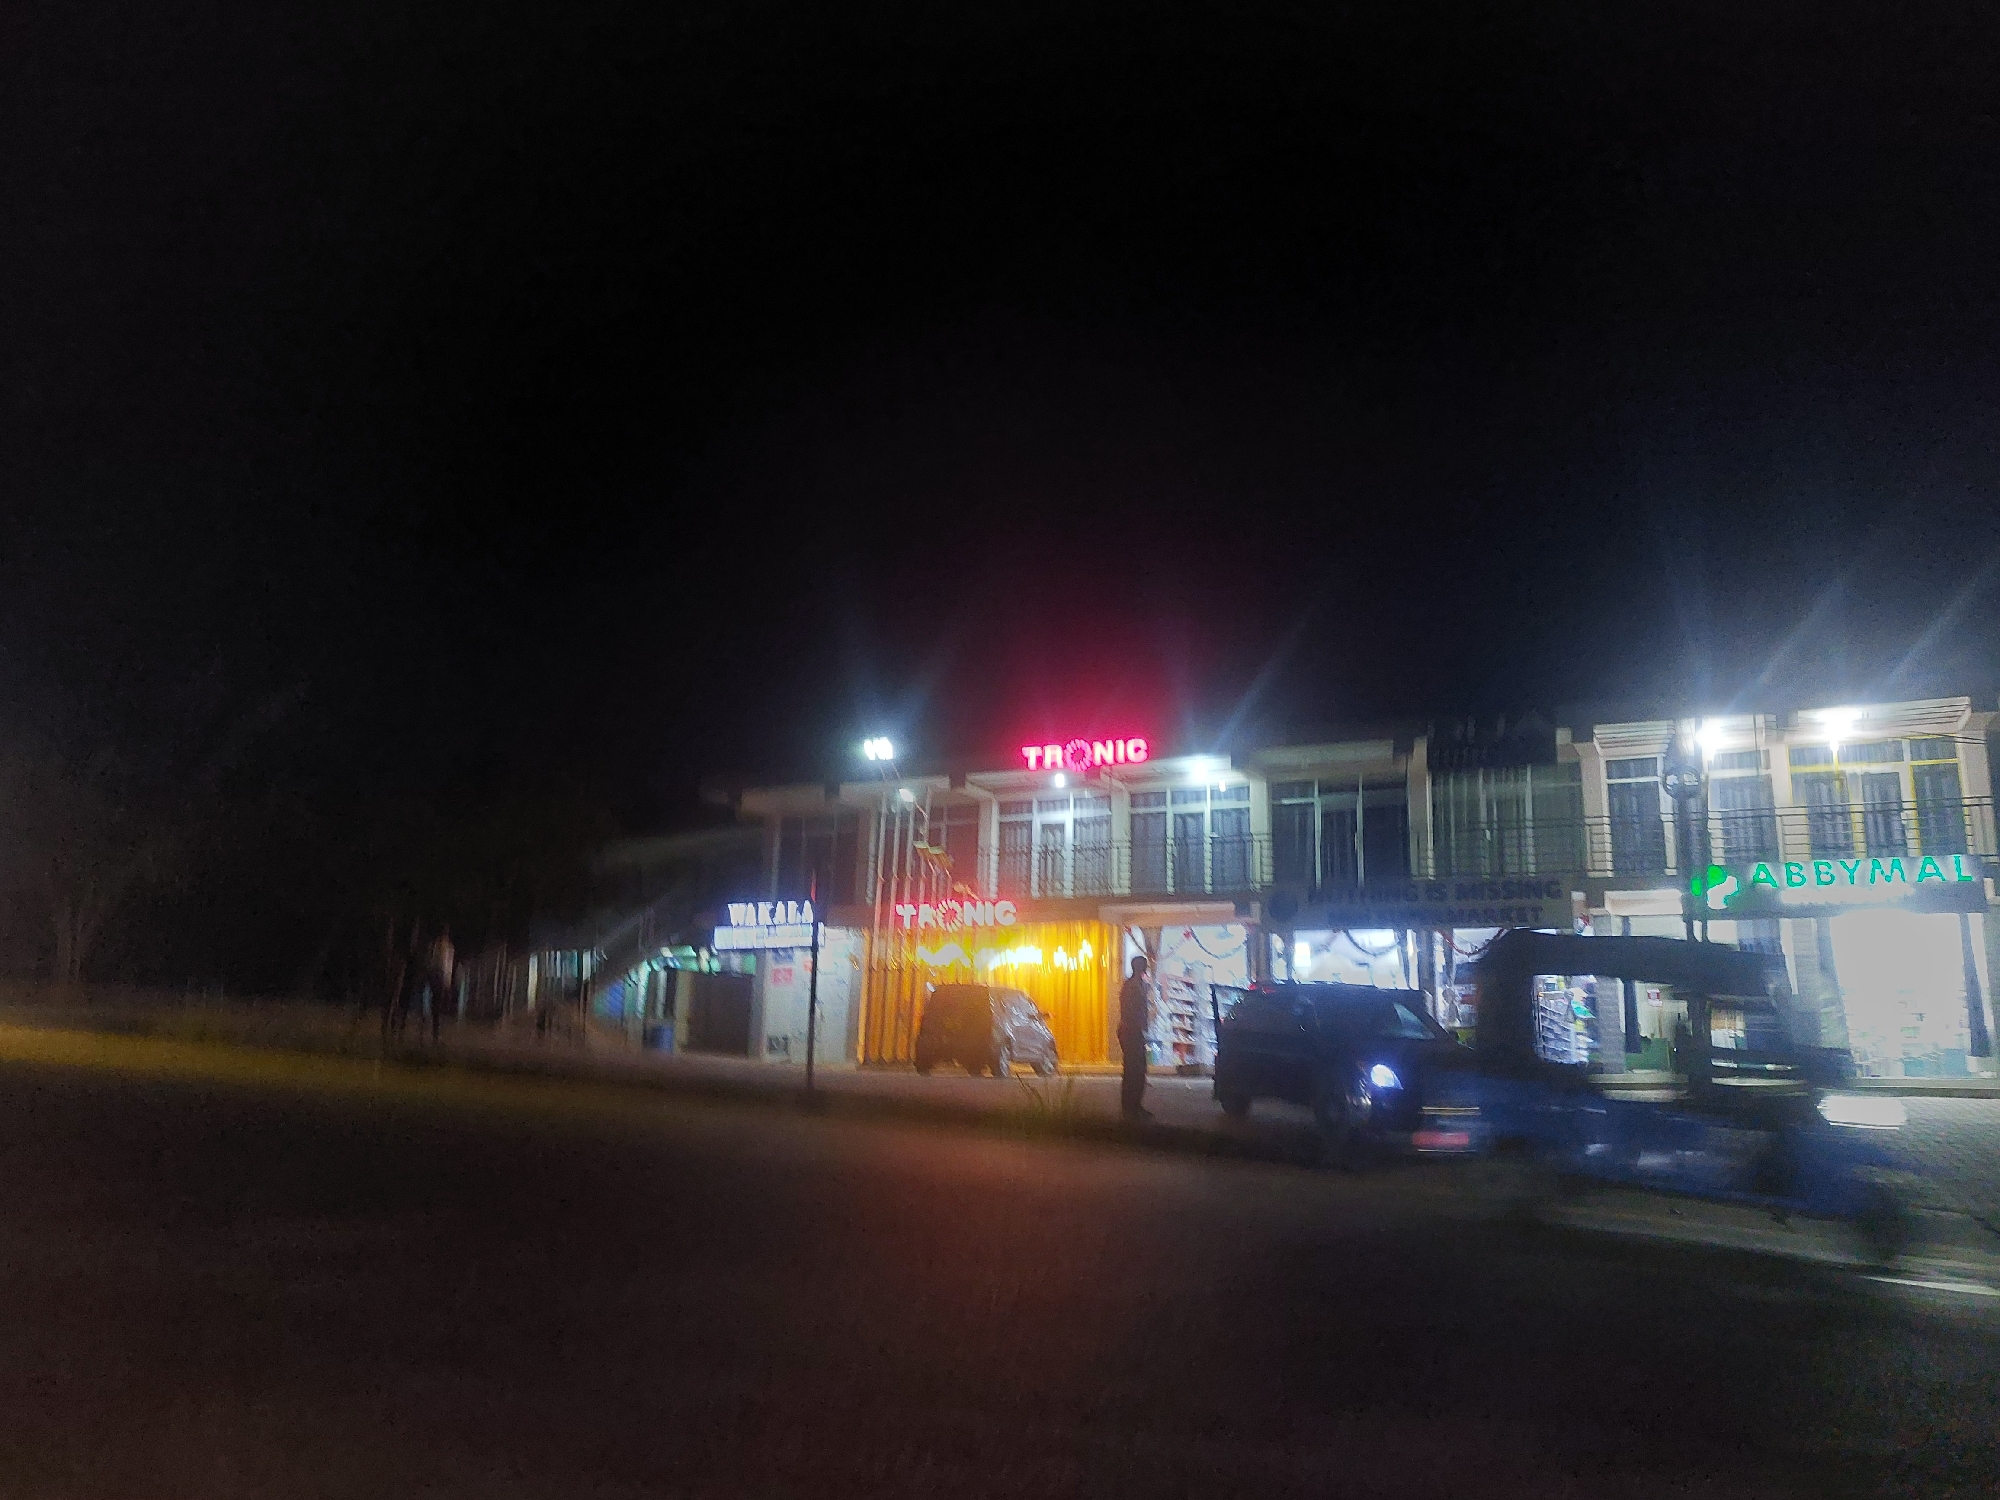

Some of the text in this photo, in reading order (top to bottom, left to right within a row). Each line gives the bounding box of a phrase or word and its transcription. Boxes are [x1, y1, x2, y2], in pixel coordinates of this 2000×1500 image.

[1022, 738, 1149, 771] TRONIC
[1752, 855, 1973, 887] ABBYMAL
[1425, 882, 1447, 901] IS
[1455, 878, 1563, 900] MISSING
[727, 900, 813, 926] WAKALA
[896, 899, 1017, 933] TRONIC
